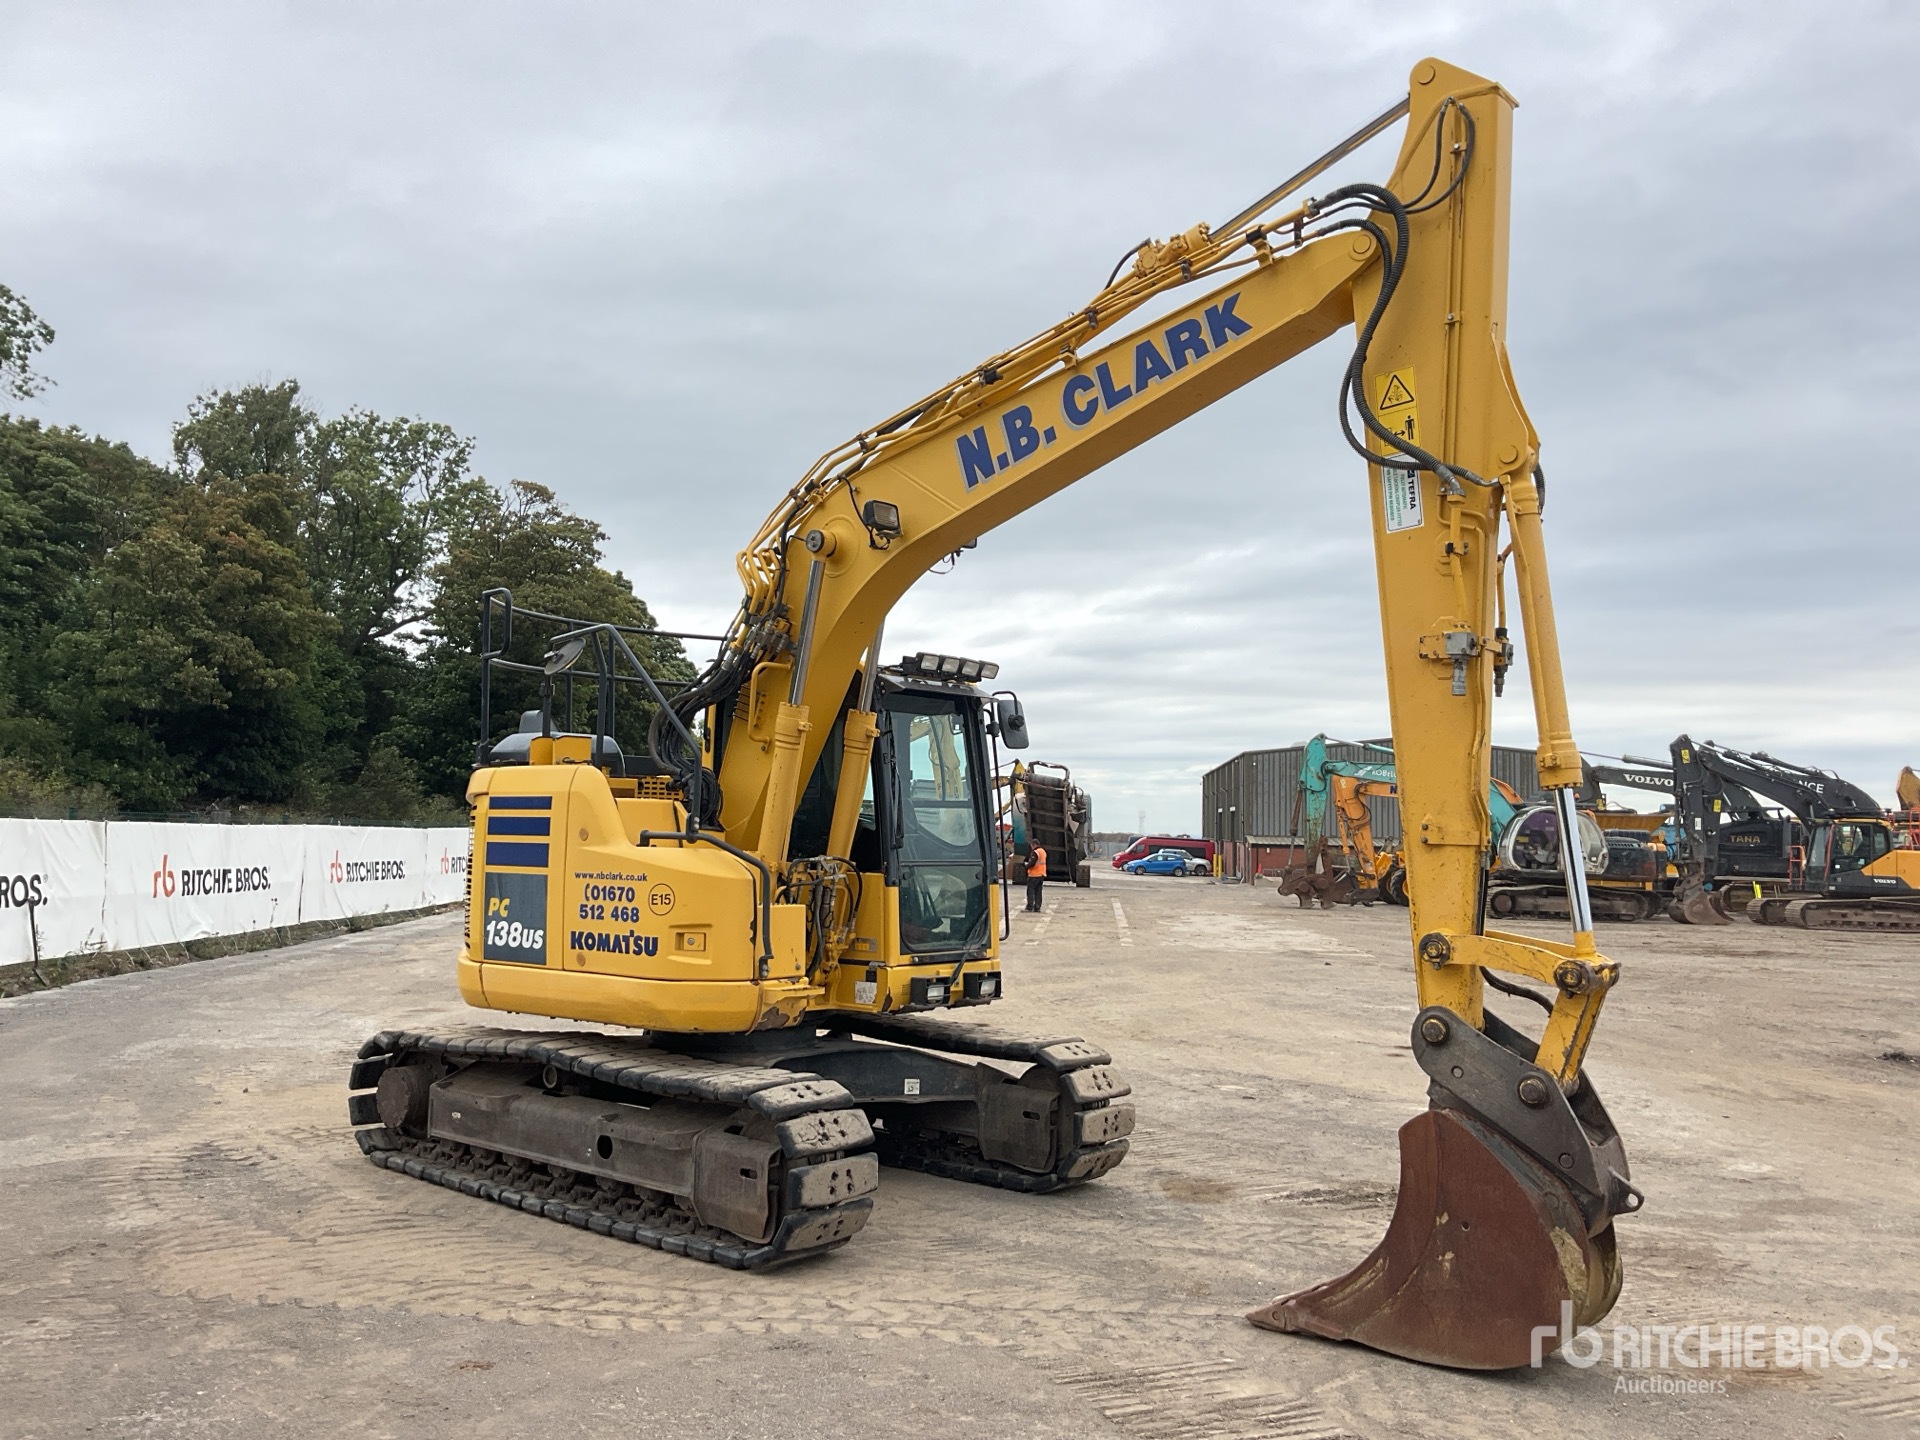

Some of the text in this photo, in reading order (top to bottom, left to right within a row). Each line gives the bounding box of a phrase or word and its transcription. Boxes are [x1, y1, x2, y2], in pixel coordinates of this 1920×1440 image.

[955, 291, 1253, 491] N.B. CLARK
[1408, 479, 1416, 510] TEFRA
[1623, 773, 1674, 787] VOLVO
[1798, 780, 1825, 794] NCE
[1730, 835, 1761, 844] TANA
[346, 861, 380, 883] RITCHIE
[381, 860, 406, 880] BROS.
[574, 871, 648, 882] www.nbclark.co.uk
[181, 868, 233, 897] RITCHIE
[235, 866, 271, 892] BROS.
[488, 897, 510, 917] PC
[651, 893, 672, 906] E15
[579, 904, 640, 923] 512 468
[570, 930, 659, 957] KOMATSU
